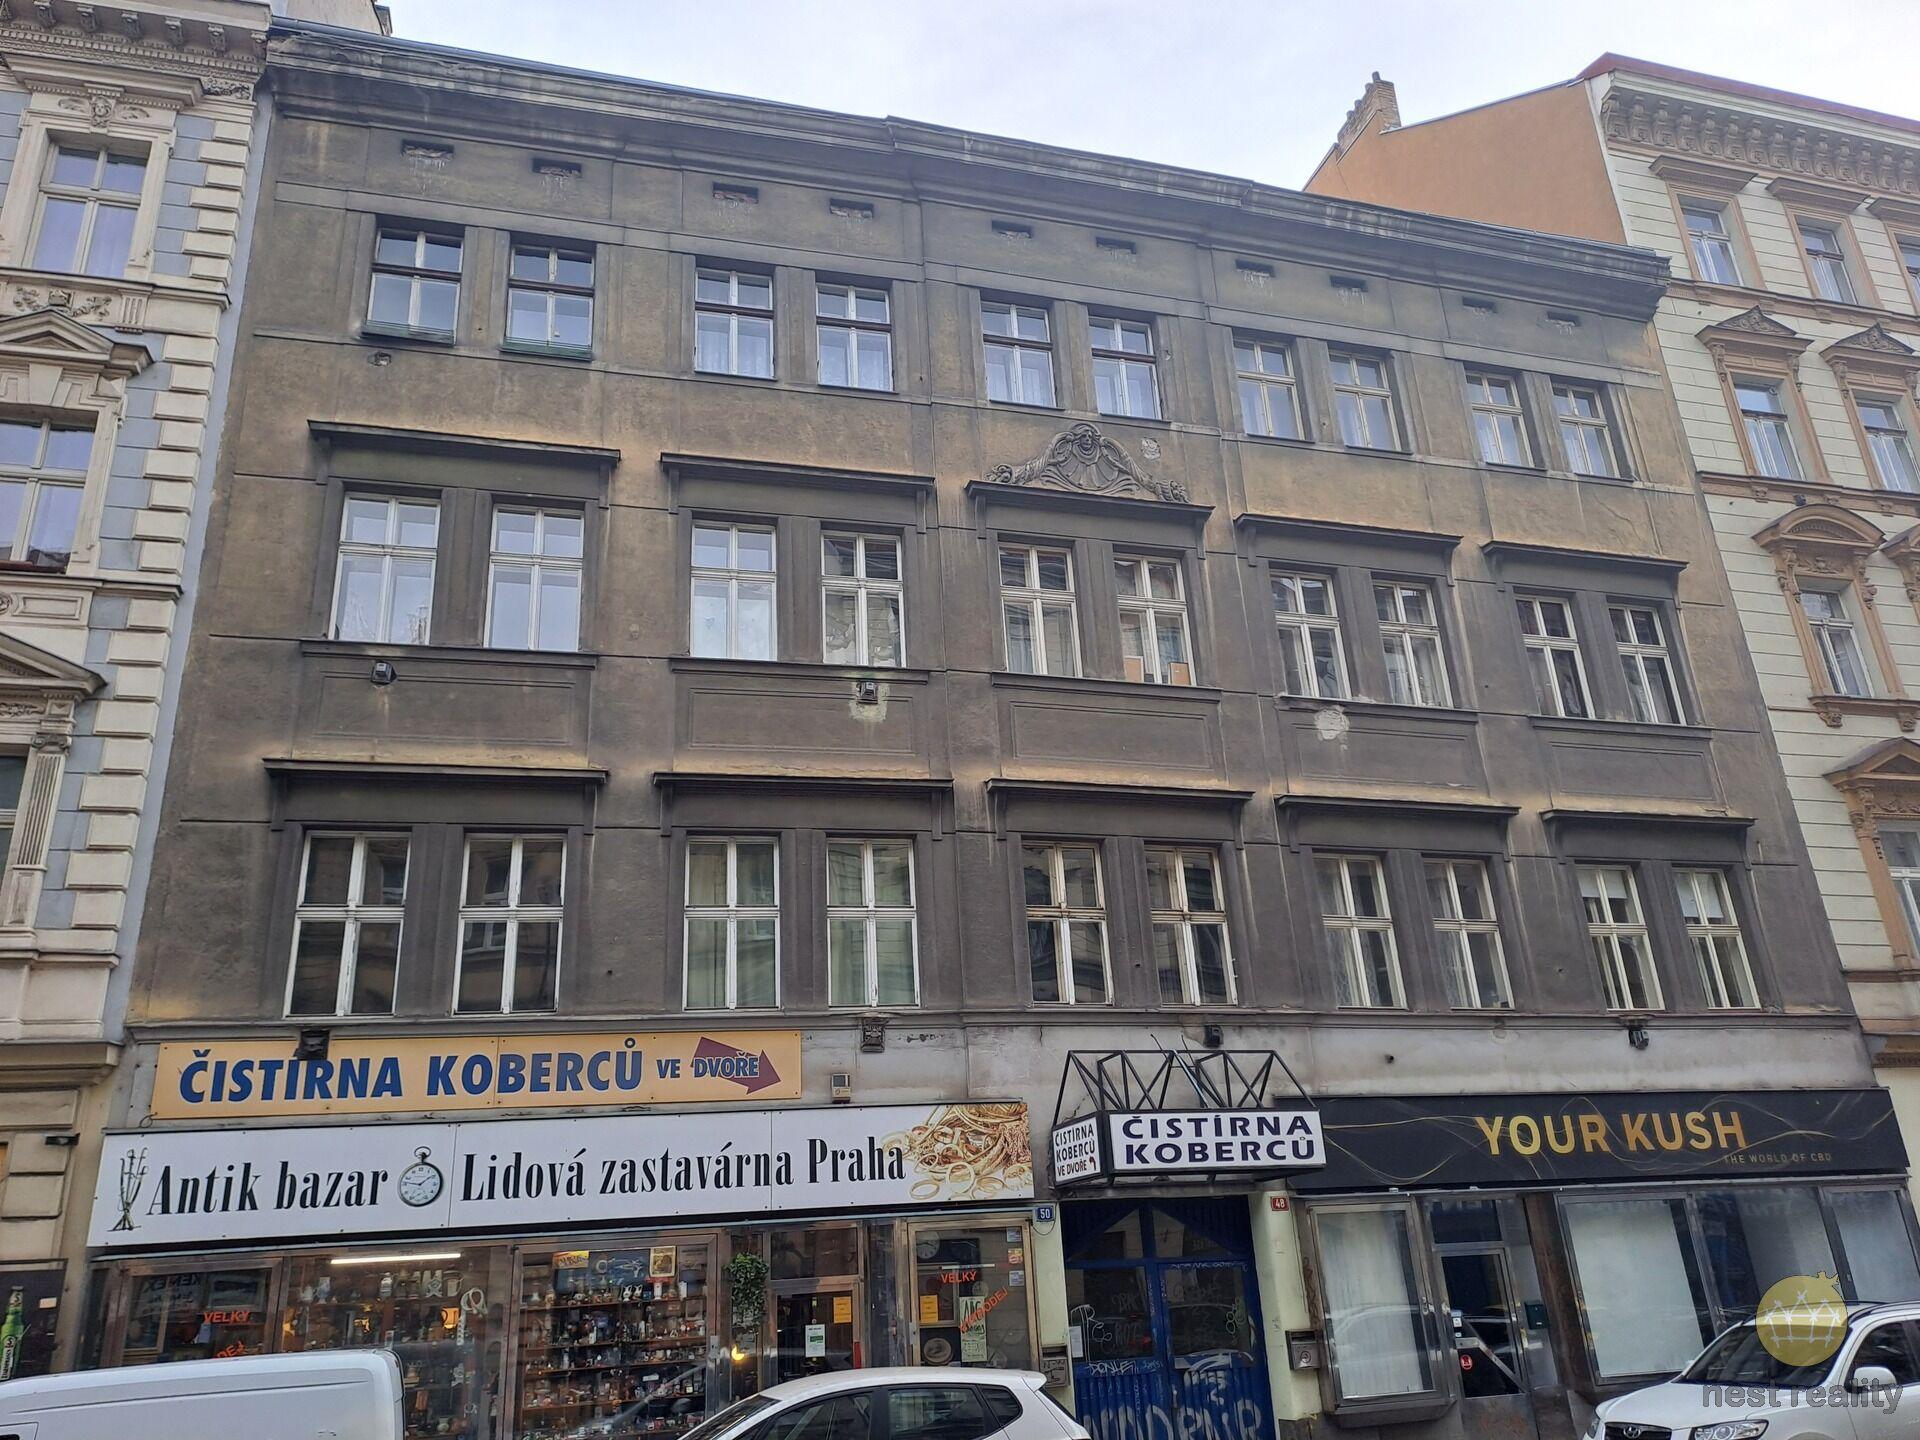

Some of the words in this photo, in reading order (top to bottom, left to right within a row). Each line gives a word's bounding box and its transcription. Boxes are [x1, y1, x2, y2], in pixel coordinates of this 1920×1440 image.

[425, 1038, 643, 1097] KOBERCŮ
[656, 1058, 681, 1079] VE
[693, 1051, 760, 1078] DVOŘE
[1055, 1123, 1095, 1147] ČISTÍRNA
[1122, 1114, 1313, 1140] ČISTÍRNA
[1473, 1113, 1611, 1156] YOUR
[1621, 1111, 1748, 1152] KUSH
[1056, 1138, 1096, 1163] KOBERCŮ
[1125, 1136, 1315, 1165] KOBERCŮ
[1749, 1153, 1786, 1165] WORLD
[1791, 1153, 1806, 1164] OF
[1811, 1152, 1832, 1163] CBD
[460, 1141, 587, 1202] Lidová
[599, 1141, 795, 1195] zastavárna
[807, 1136, 907, 1185] Praha
[1057, 1165, 1065, 1177] VE
[145, 1161, 262, 1216] Antik
[273, 1160, 389, 1210] bazar
[1040, 1208, 1051, 1219] 50
[1274, 1199, 1286, 1209] 48
